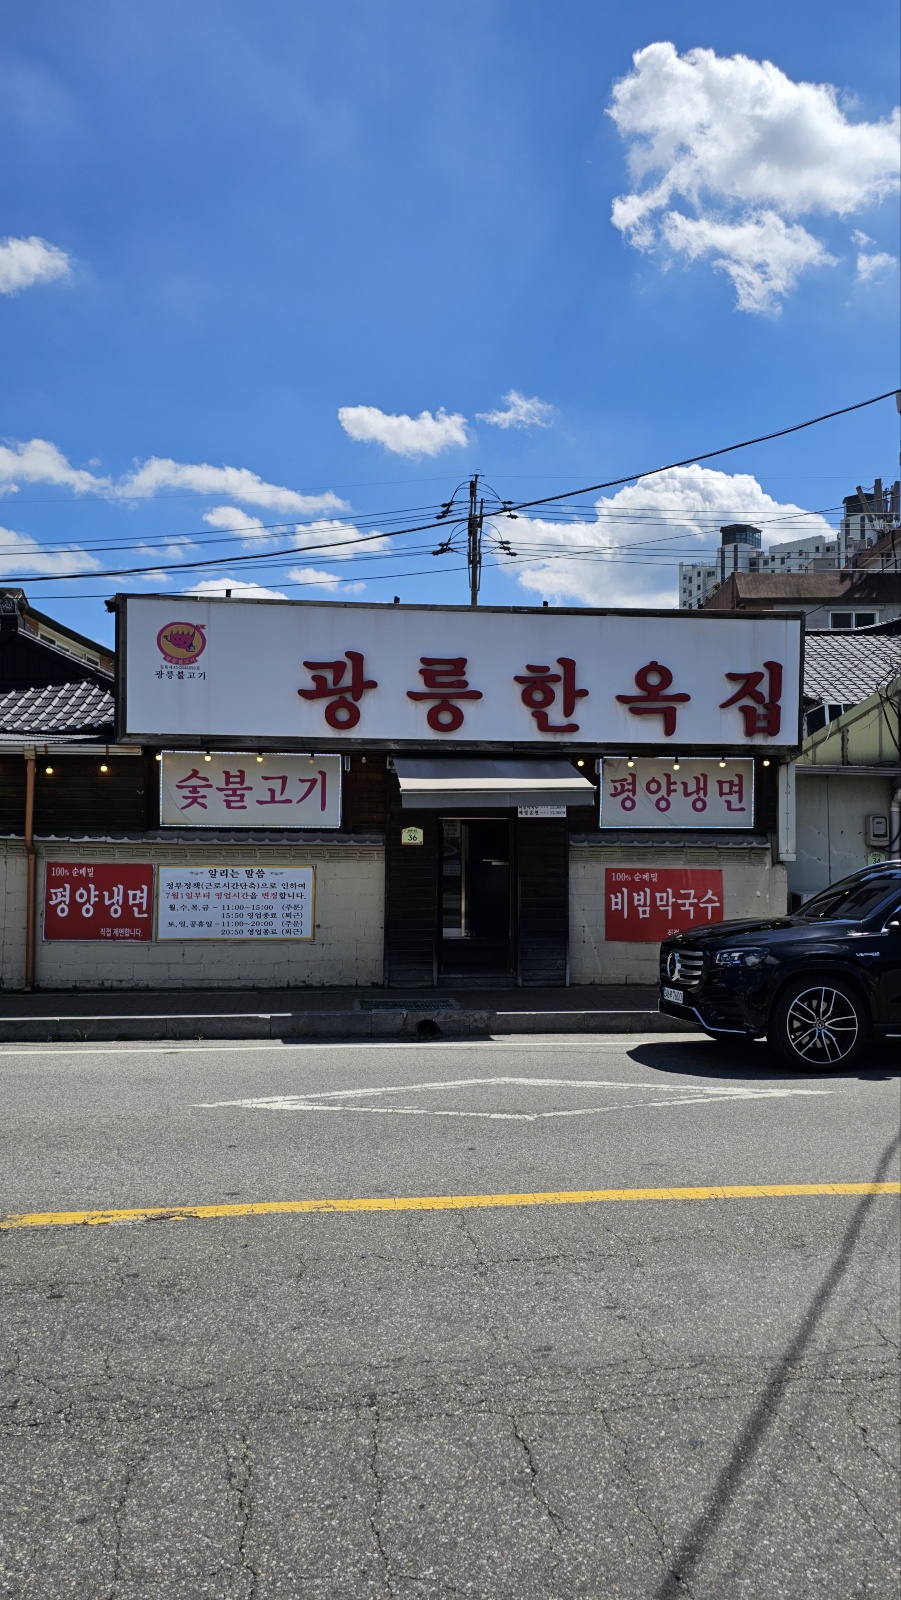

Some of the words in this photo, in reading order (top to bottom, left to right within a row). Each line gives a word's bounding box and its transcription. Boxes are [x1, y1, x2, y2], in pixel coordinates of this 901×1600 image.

[155, 670, 206, 681] 광릉불고기
[297, 650, 783, 737] 광릉한옥집
[175, 768, 327, 812] 숯불고기
[609, 772, 746, 813] 평양냉면
[51, 867, 69, 876] 100%
[71, 867, 94, 877] 순메밀
[208, 868, 240, 879] 알리는
[244, 868, 266, 879] 말씀
[612, 872, 631, 881] 100%
[633, 872, 658, 882] 순메밀
[281, 881, 306, 890] 인하여
[48, 883, 149, 918] 평양냉면
[165, 891, 211, 900] 7월1일부터
[214, 891, 258, 900] 영업시간을
[261, 891, 307, 900] 변경합니다.
[281, 903, 304, 912] (주문)
[609, 887, 721, 920] 비빔막국수
[247, 912, 278, 920] 영업종료
[281, 920, 303, 928] (주문)
[100, 928, 112, 937] 직접
[220, 928, 244, 936] 20:50
[247, 928, 278, 936] 영업종료
